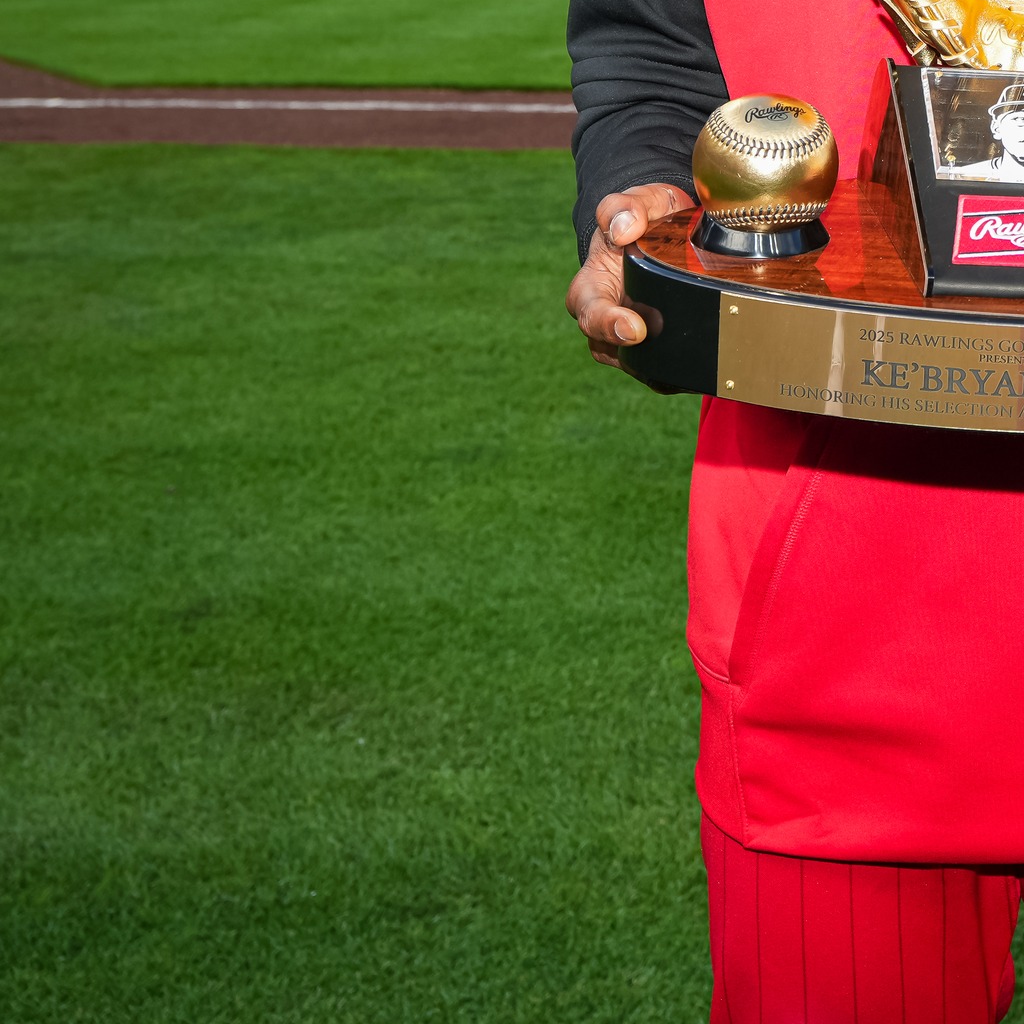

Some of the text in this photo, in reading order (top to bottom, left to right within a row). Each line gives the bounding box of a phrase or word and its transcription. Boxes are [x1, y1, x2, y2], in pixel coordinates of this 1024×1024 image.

[744, 102, 806, 123] Rawlings
[859, 328, 894, 344] 2025
[899, 333, 993, 352] RAWLINGS
[780, 383, 877, 407] HONORING
[881, 396, 910, 411] HIS
[914, 399, 1014, 418] SELECTION
